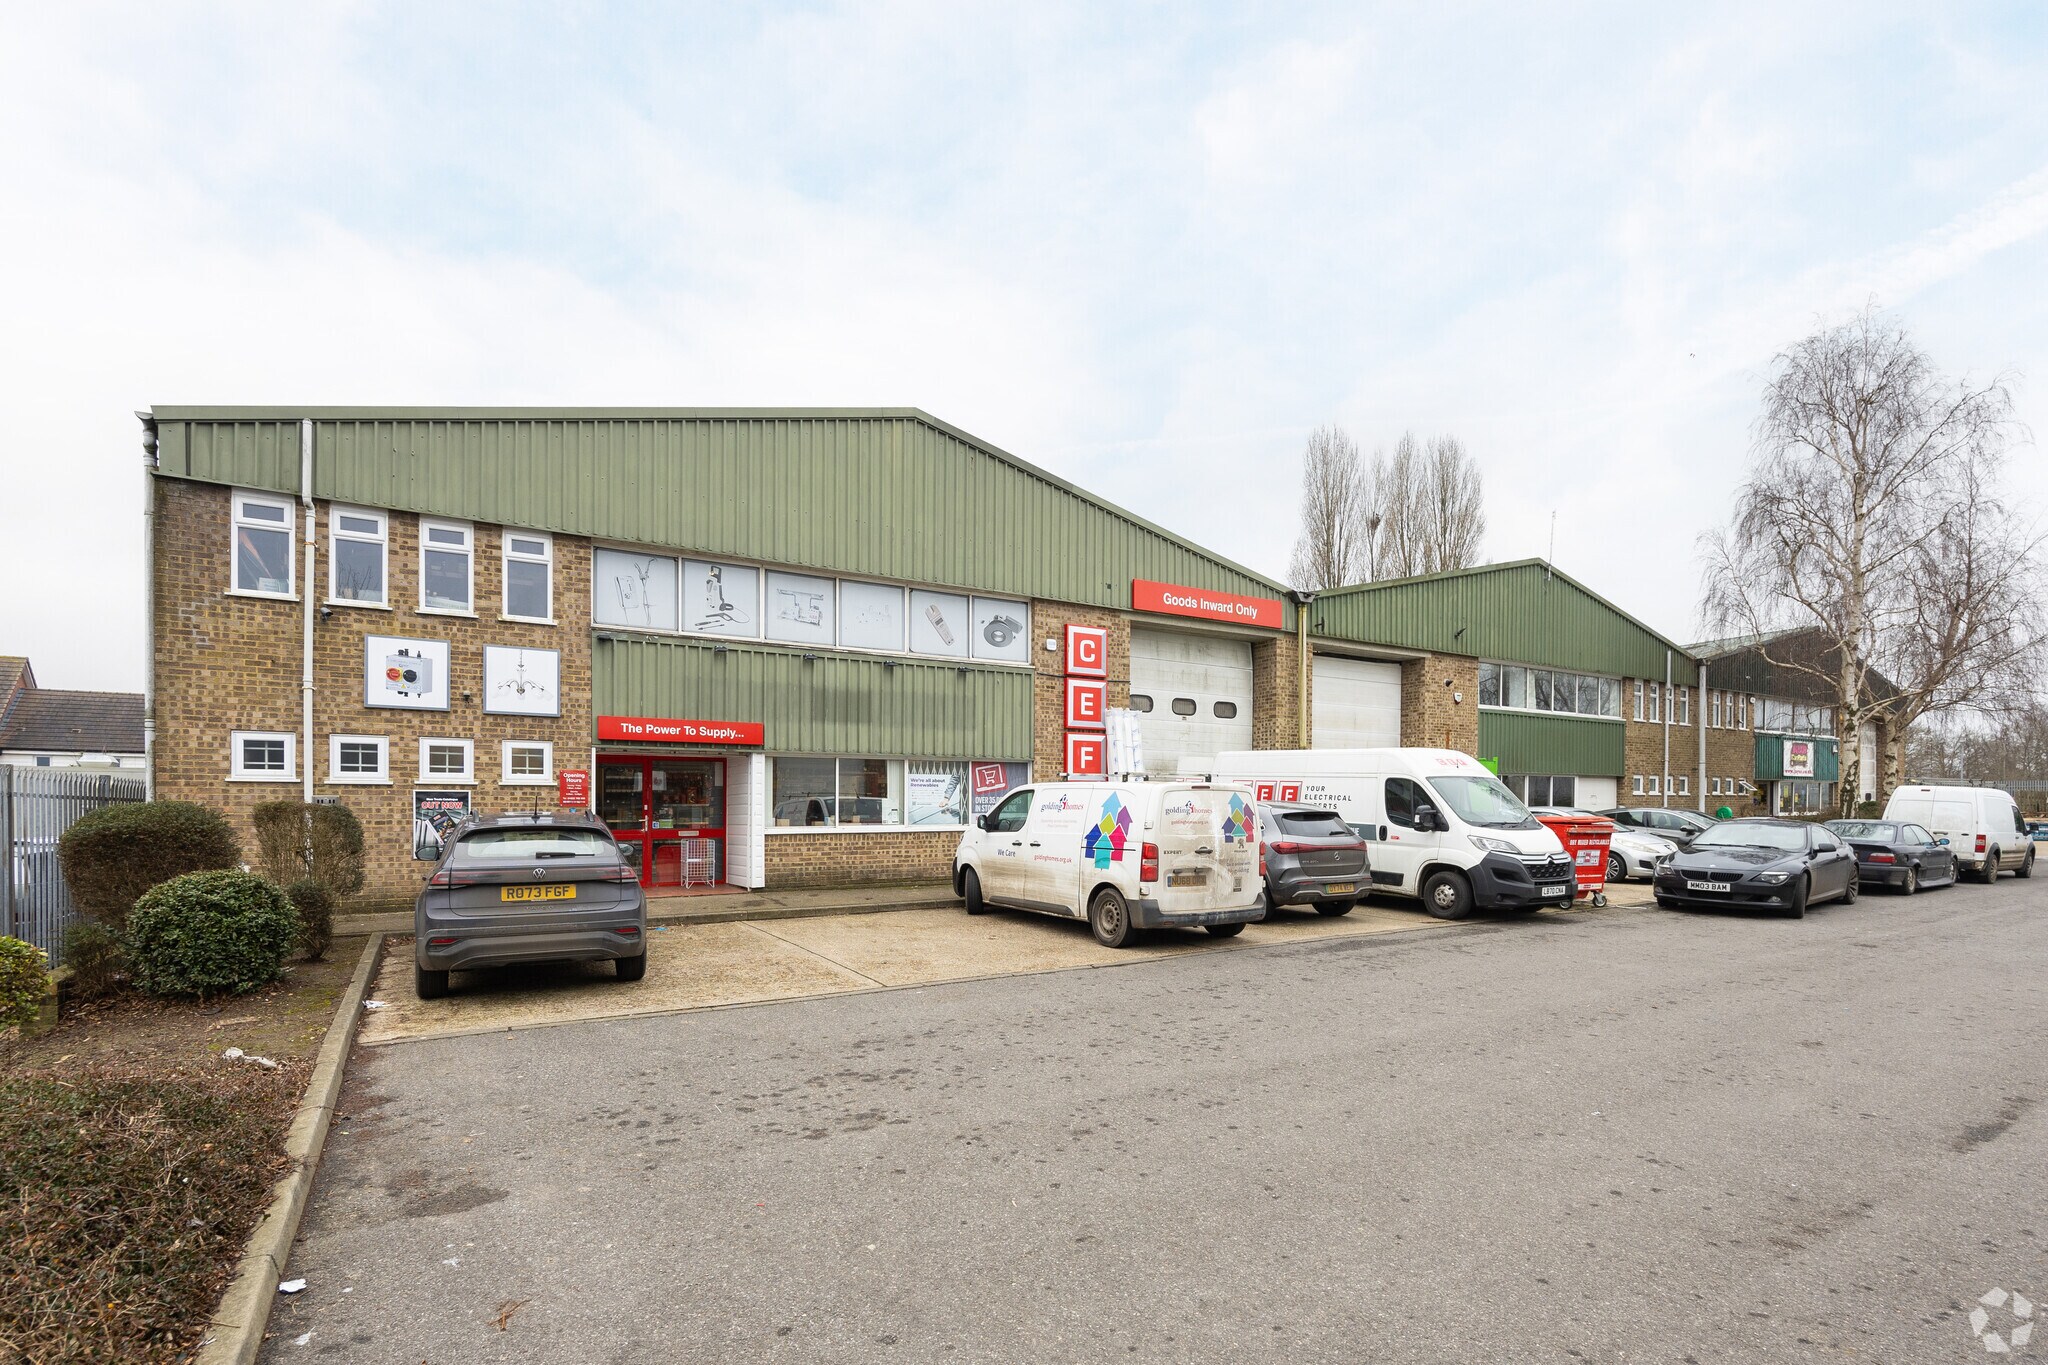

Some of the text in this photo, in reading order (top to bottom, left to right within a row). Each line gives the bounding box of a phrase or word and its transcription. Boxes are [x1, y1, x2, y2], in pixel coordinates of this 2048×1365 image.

[1163, 592, 1258, 619] Goods Inward Only
[1079, 639, 1096, 663] C
[1080, 692, 1094, 716] E
[621, 723, 745, 739] The Power To Supply...
[1080, 746, 1094, 769] F
[975, 796, 989, 804] OVER
[1304, 793, 1352, 802] ELECTRICAL
[421, 801, 463, 809] OUT NOW
[975, 804, 981, 812] IN
[981, 804, 992, 812] STO
[1040, 802, 1062, 813] golding
[1165, 806, 1213, 816] golding homes
[997, 848, 1016, 858] We Care
[545, 886, 570, 898] FGF
[1711, 883, 1727, 891] BAM
